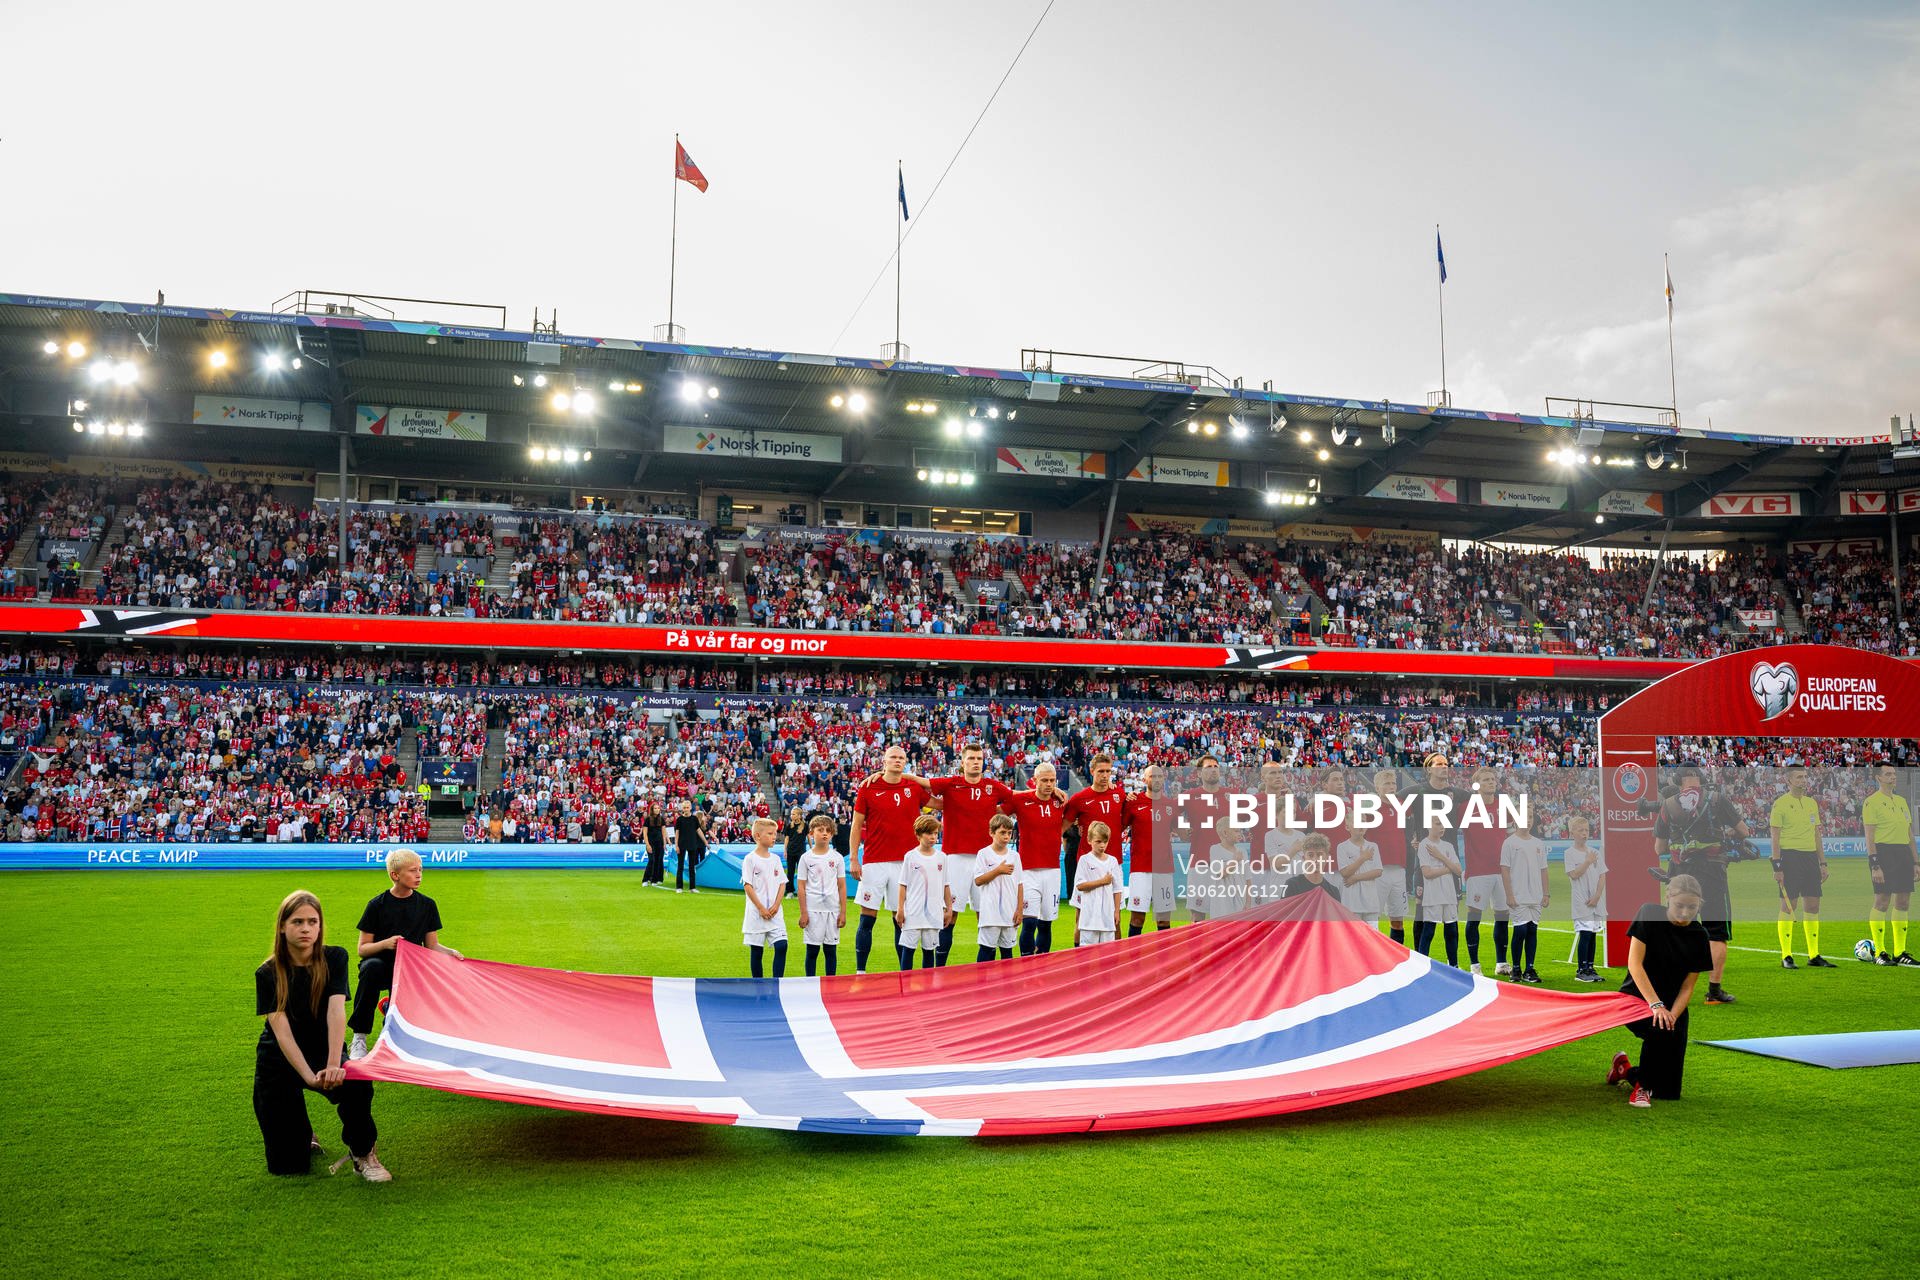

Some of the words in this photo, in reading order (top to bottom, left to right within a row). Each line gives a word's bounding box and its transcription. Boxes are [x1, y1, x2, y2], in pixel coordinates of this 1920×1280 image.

[239, 409, 267, 419] Norsk
[268, 410, 304, 423] Tipping
[417, 425, 442, 438] sjanse!
[720, 437, 759, 451] Norsk
[761, 439, 812, 458] Tipping
[1801, 437, 1828, 445] VG
[114, 463, 139, 473] Norsk
[141, 465, 173, 476] Tipping
[1159, 467, 1181, 476] Norsk
[1183, 468, 1209, 480] Tipping
[1508, 492, 1527, 501] Norsk
[1527, 493, 1552, 504] Tipping
[1711, 496, 1788, 514] VG
[779, 530, 804, 540] Norsk
[1311, 529, 1330, 538] Norsk
[1330, 530, 1353, 540] Tipping
[1738, 611, 1771, 620] VG
[666, 630, 690, 647] På
[695, 631, 725, 649] vår
[730, 634, 756, 649] far
[760, 637, 786, 653] og
[790, 638, 828, 652] mor
[1807, 677, 1877, 693] EUROPEAN
[649, 697, 670, 705] Norsk
[726, 698, 747, 706] Norsk
[1799, 692, 1887, 712] QUALIFIERS
[970, 705, 990, 714] Tippin
[1619, 765, 1641, 775] UEFA
[448, 777, 465, 785] Tipping
[893, 792, 901, 807] 9
[970, 787, 982, 801] 19
[1039, 804, 1051, 818] 14
[1099, 800, 1111, 814] 17
[1151, 809, 1162, 822] 16
[87, 849, 141, 863] PEACE
[1160, 887, 1171, 900] 16
